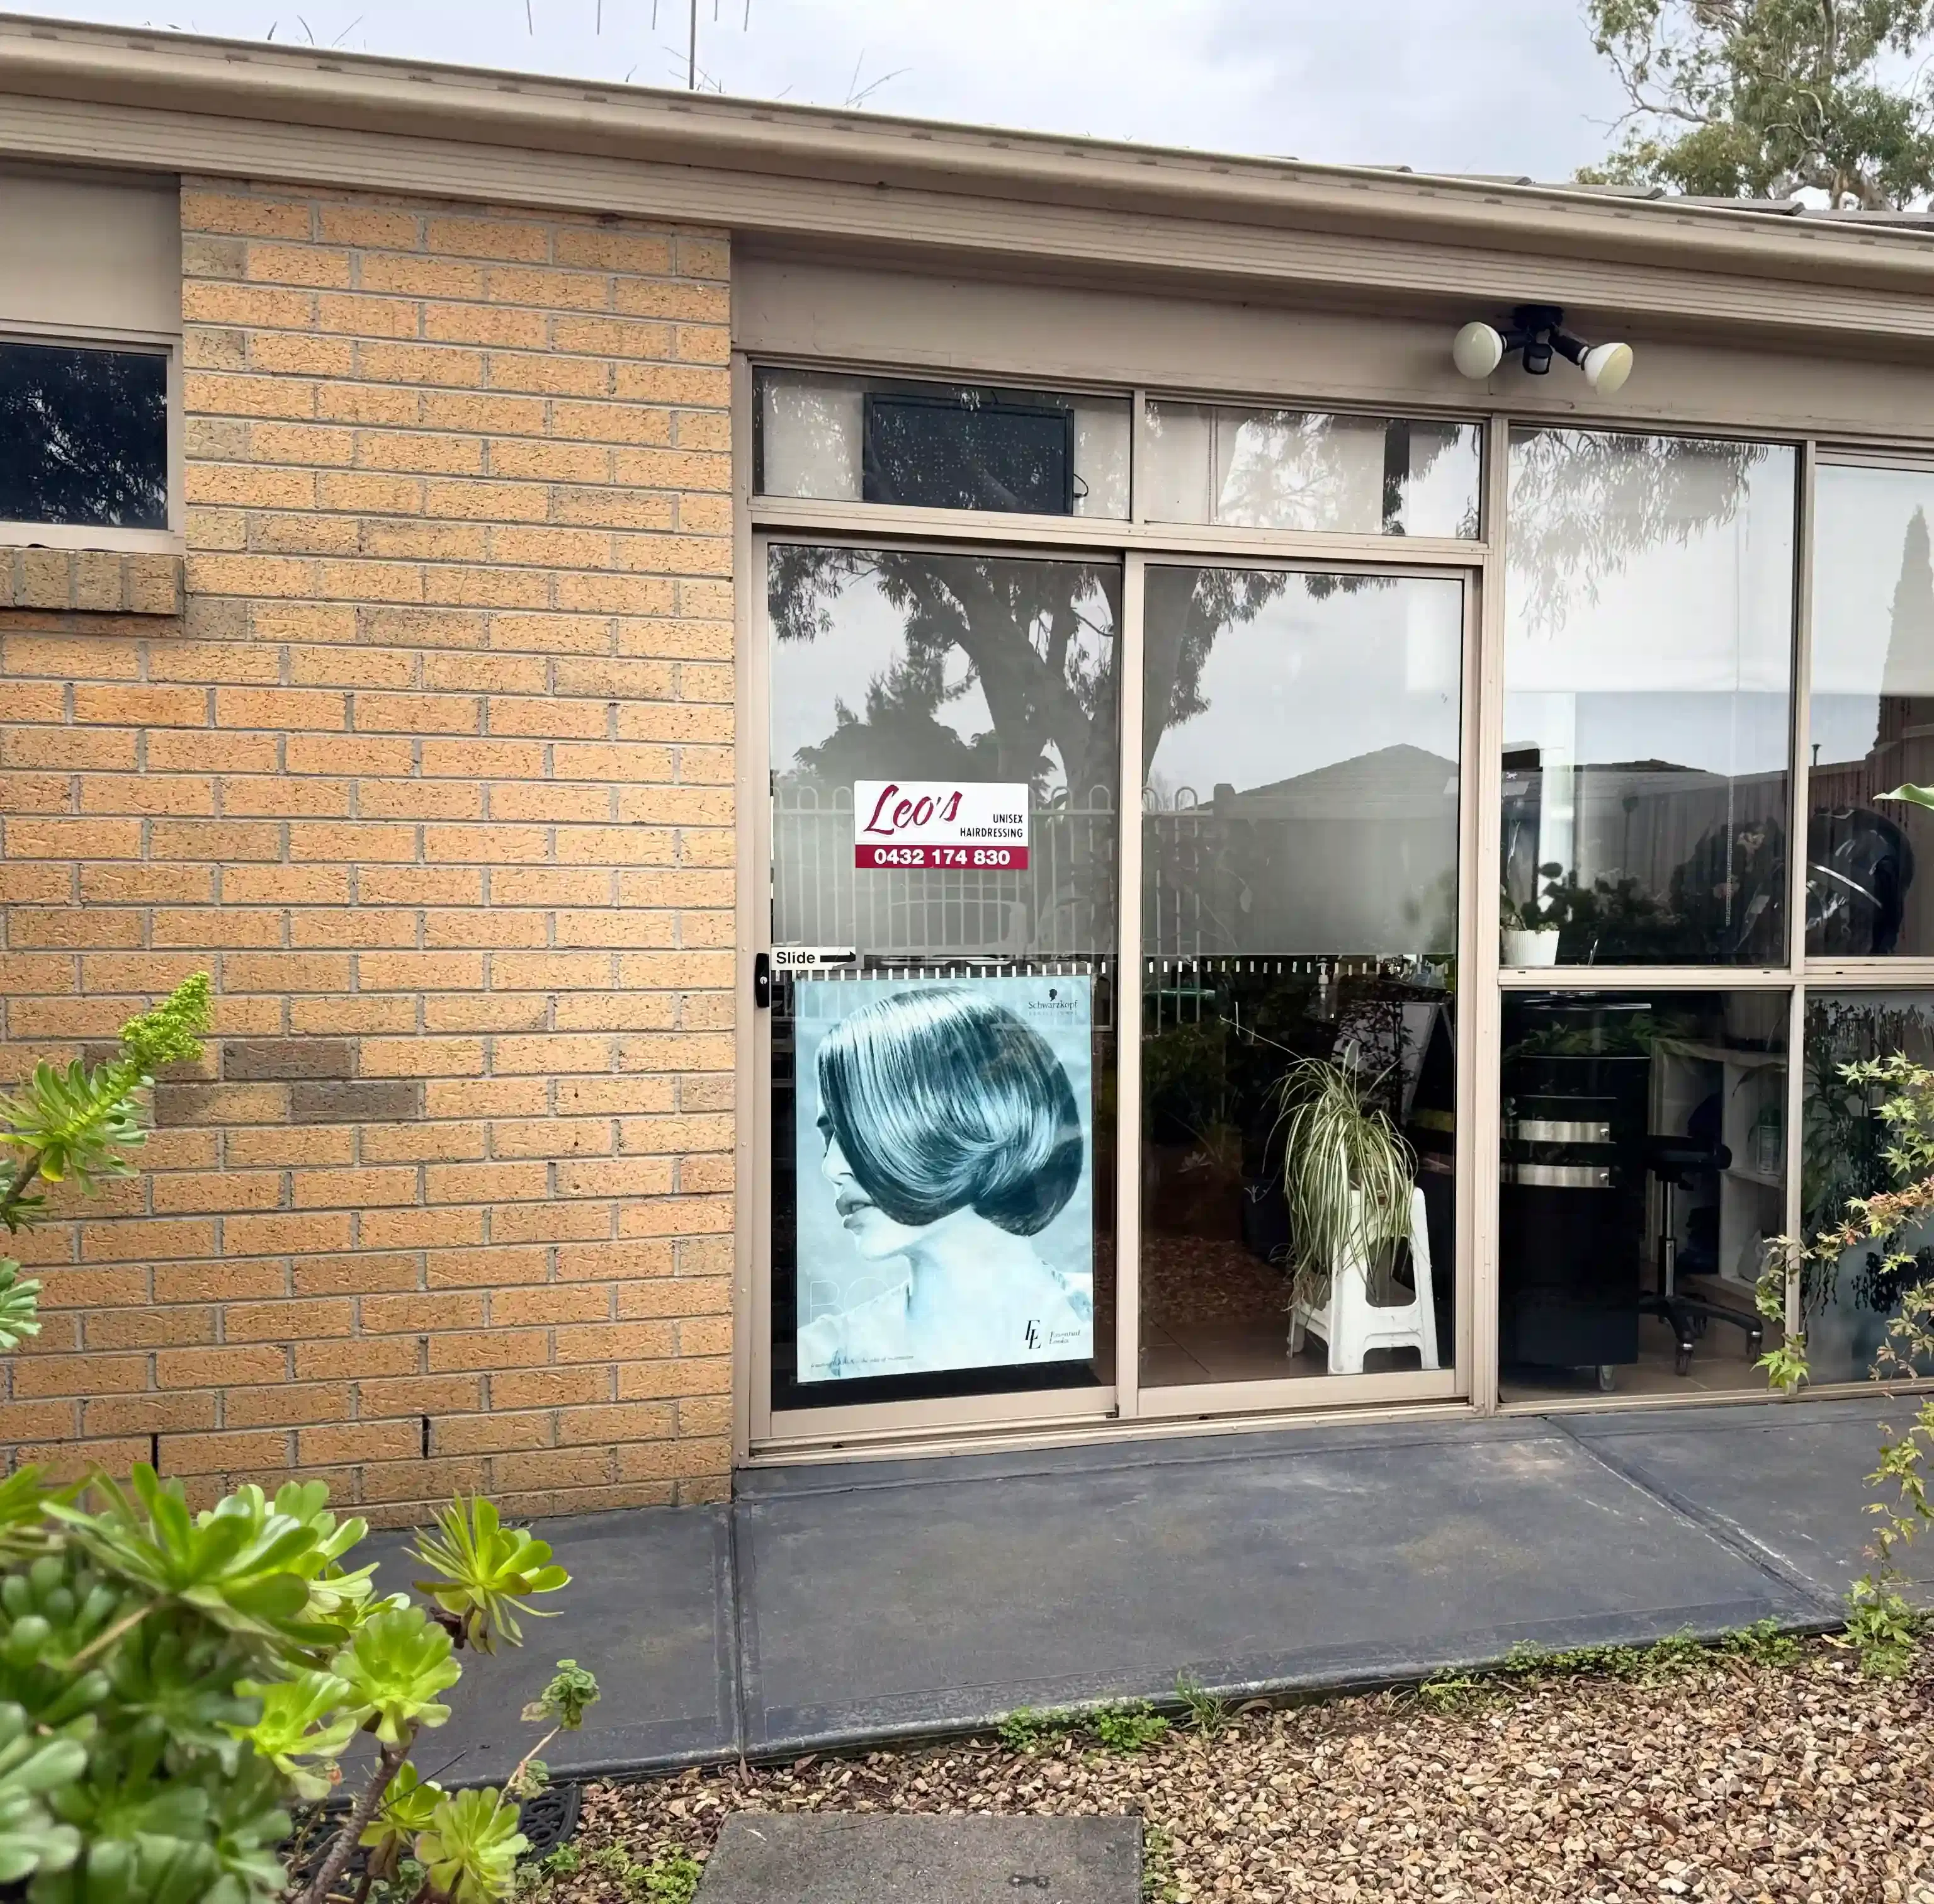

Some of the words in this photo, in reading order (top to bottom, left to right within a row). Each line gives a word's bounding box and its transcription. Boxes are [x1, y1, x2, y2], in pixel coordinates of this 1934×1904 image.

[862, 784, 963, 836] Leo's
[993, 813, 1023, 824] UNISEX
[960, 827, 1023, 838] HAIRDRESSING
[874, 849, 925, 865] 0432
[932, 849, 968, 865] 174
[973, 849, 1010, 866] 830
[776, 951, 815, 964] Slide
[1028, 999, 1078, 1010] Schwarzkopf
